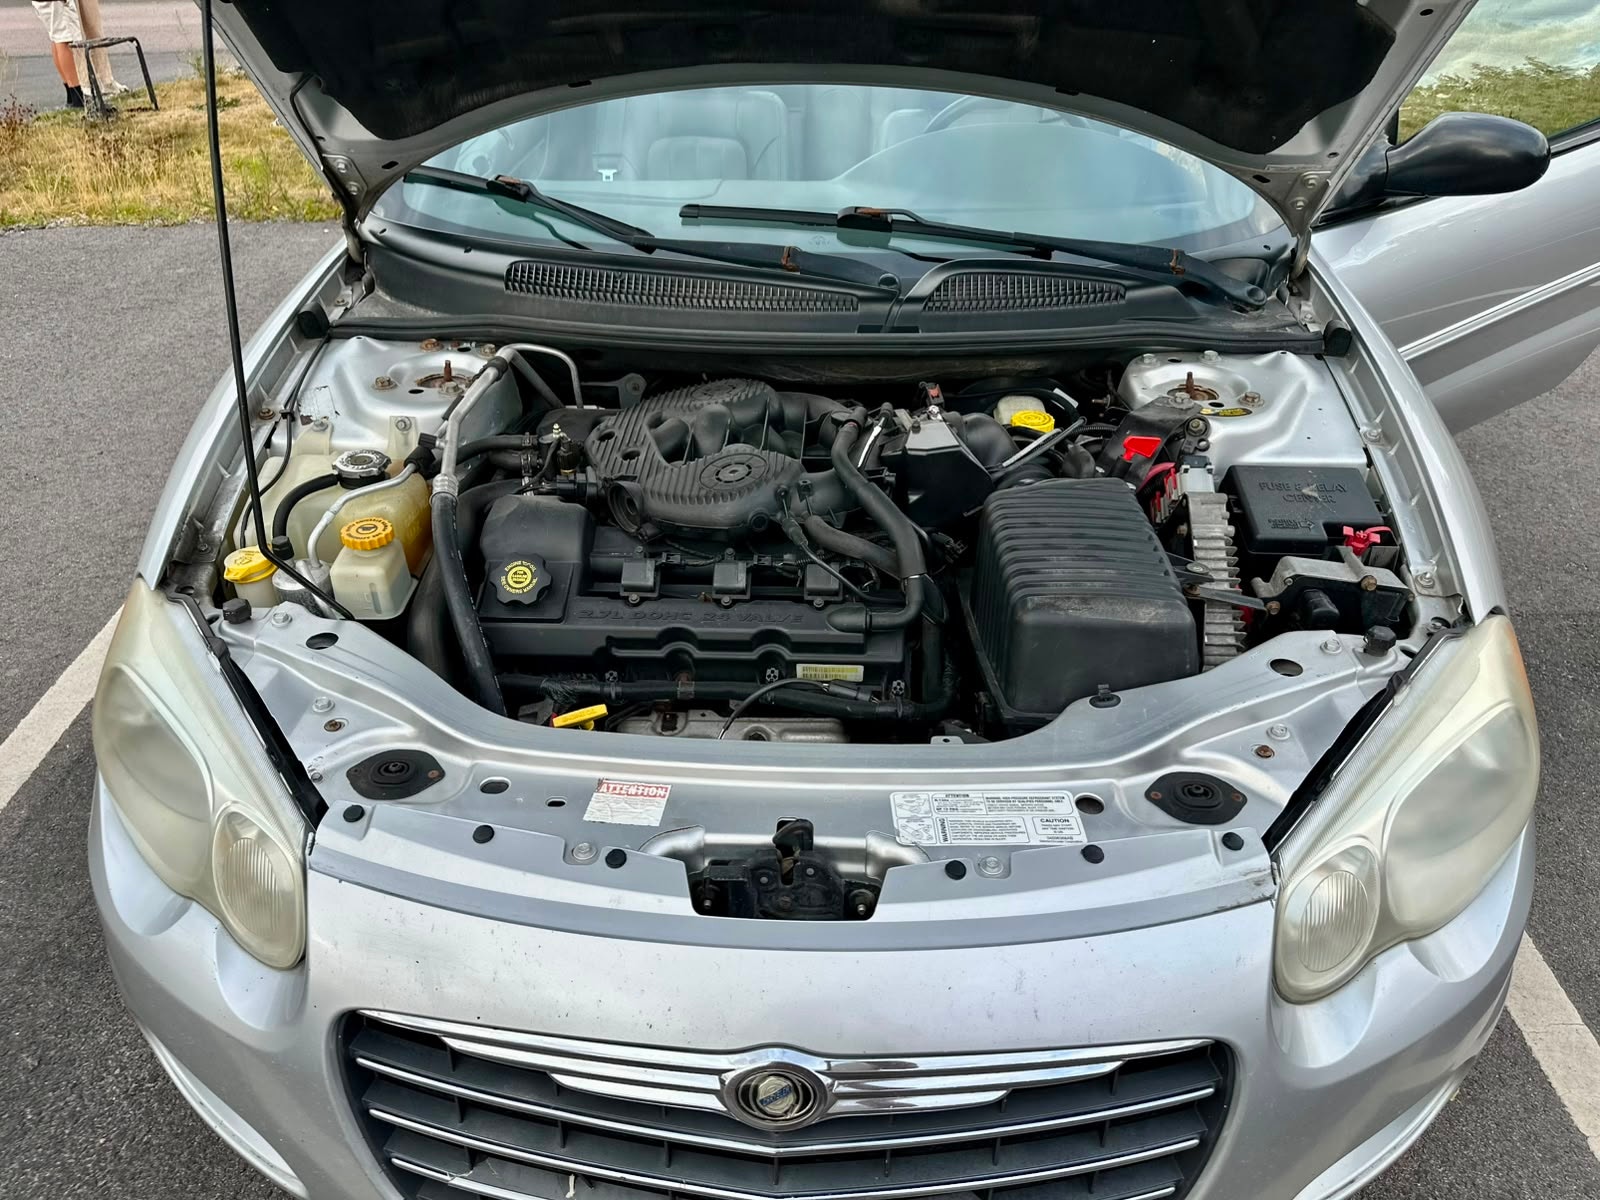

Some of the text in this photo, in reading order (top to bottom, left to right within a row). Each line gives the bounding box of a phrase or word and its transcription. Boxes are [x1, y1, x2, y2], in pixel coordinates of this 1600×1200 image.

[1259, 482, 1291, 491] FUSE
[630, 610, 693, 621] DOHC
[703, 612, 731, 622] 24
[738, 613, 804, 623] VALVE
[599, 783, 666, 797] ATTENTION
